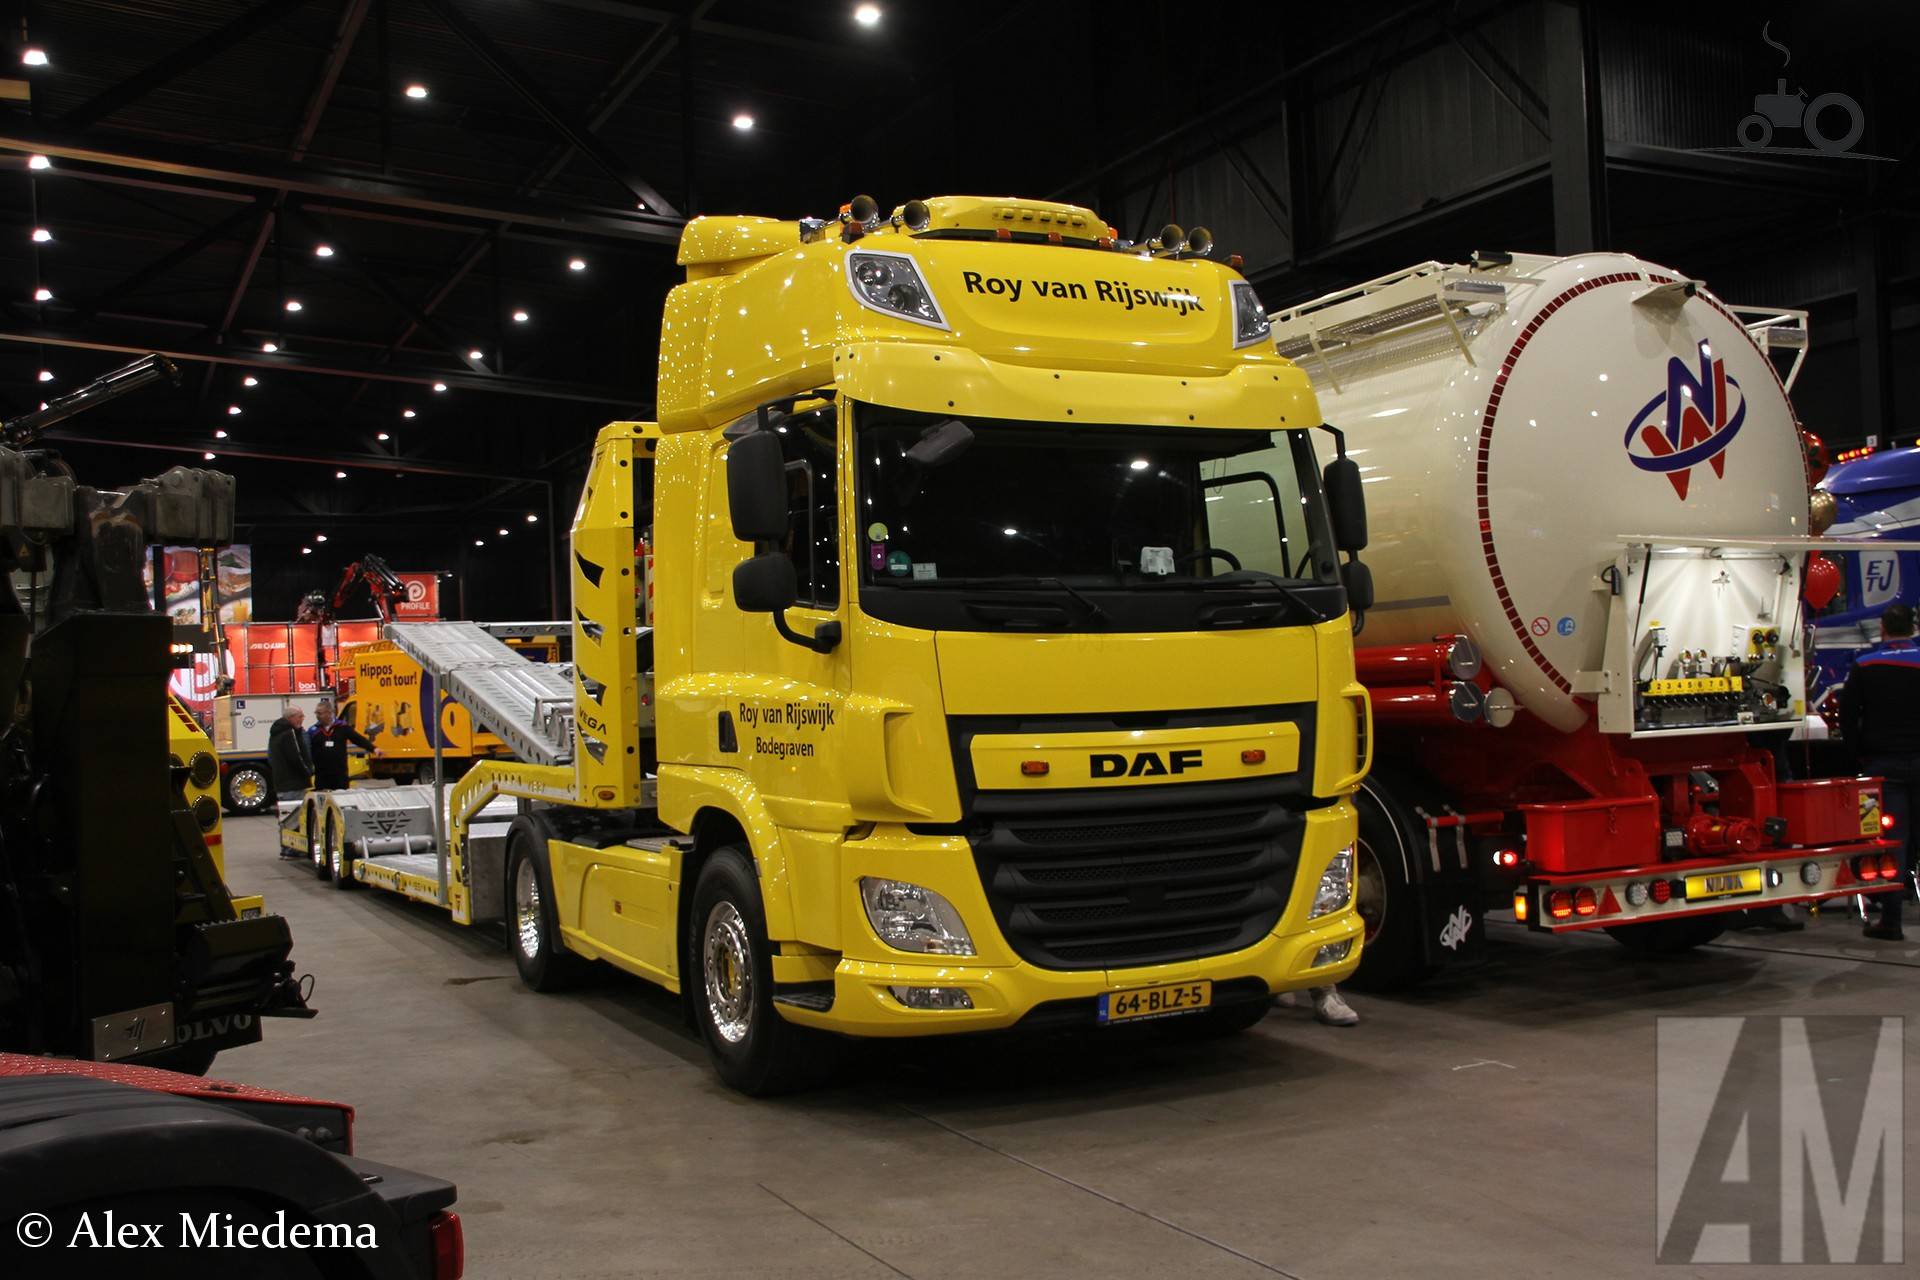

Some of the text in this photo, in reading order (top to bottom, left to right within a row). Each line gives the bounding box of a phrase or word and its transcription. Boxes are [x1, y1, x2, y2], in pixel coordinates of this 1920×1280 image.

[963, 271, 1205, 316] Roy van Rijswijk
[400, 601, 430, 610] PROFILE
[360, 663, 393, 680] Hippos
[380, 671, 417, 687] on tour!
[579, 705, 607, 735] VEGA
[739, 703, 834, 731] Roy van Rijswijk
[756, 736, 814, 760] Bodegraven
[1090, 749, 1202, 778] DAF
[1115, 985, 1202, 1014] 64-BLZ-5
[175, 1013, 252, 1043] OLVO
